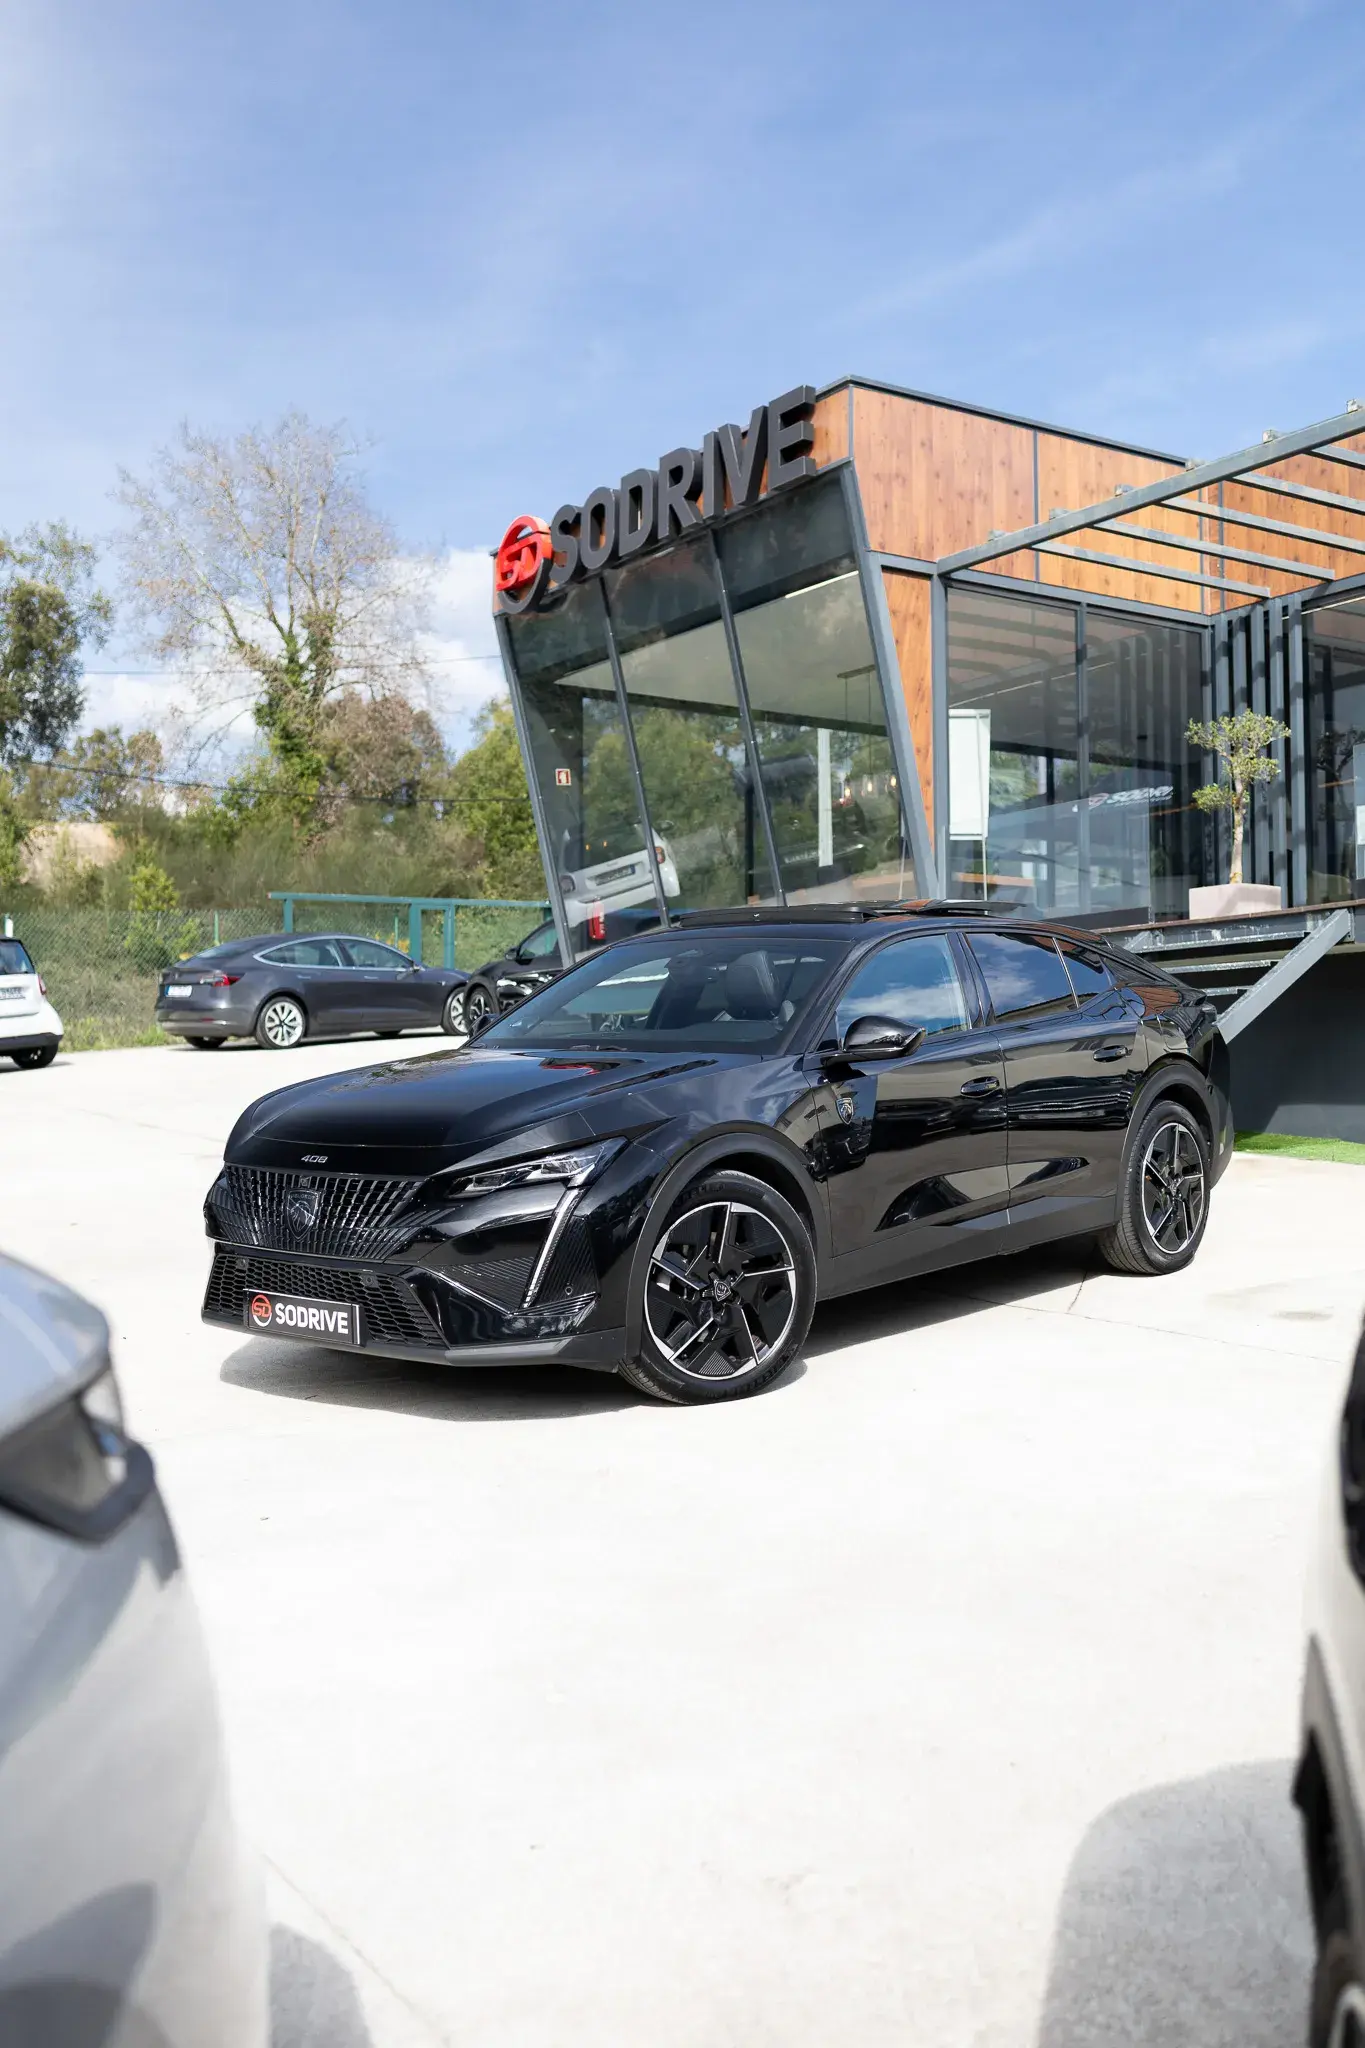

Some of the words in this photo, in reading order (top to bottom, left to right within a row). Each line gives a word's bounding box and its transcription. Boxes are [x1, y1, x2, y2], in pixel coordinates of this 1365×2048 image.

[549, 385, 816, 585] SODRIVE
[301, 1154, 329, 1163] 408
[275, 1302, 348, 1334] SODRIVE
